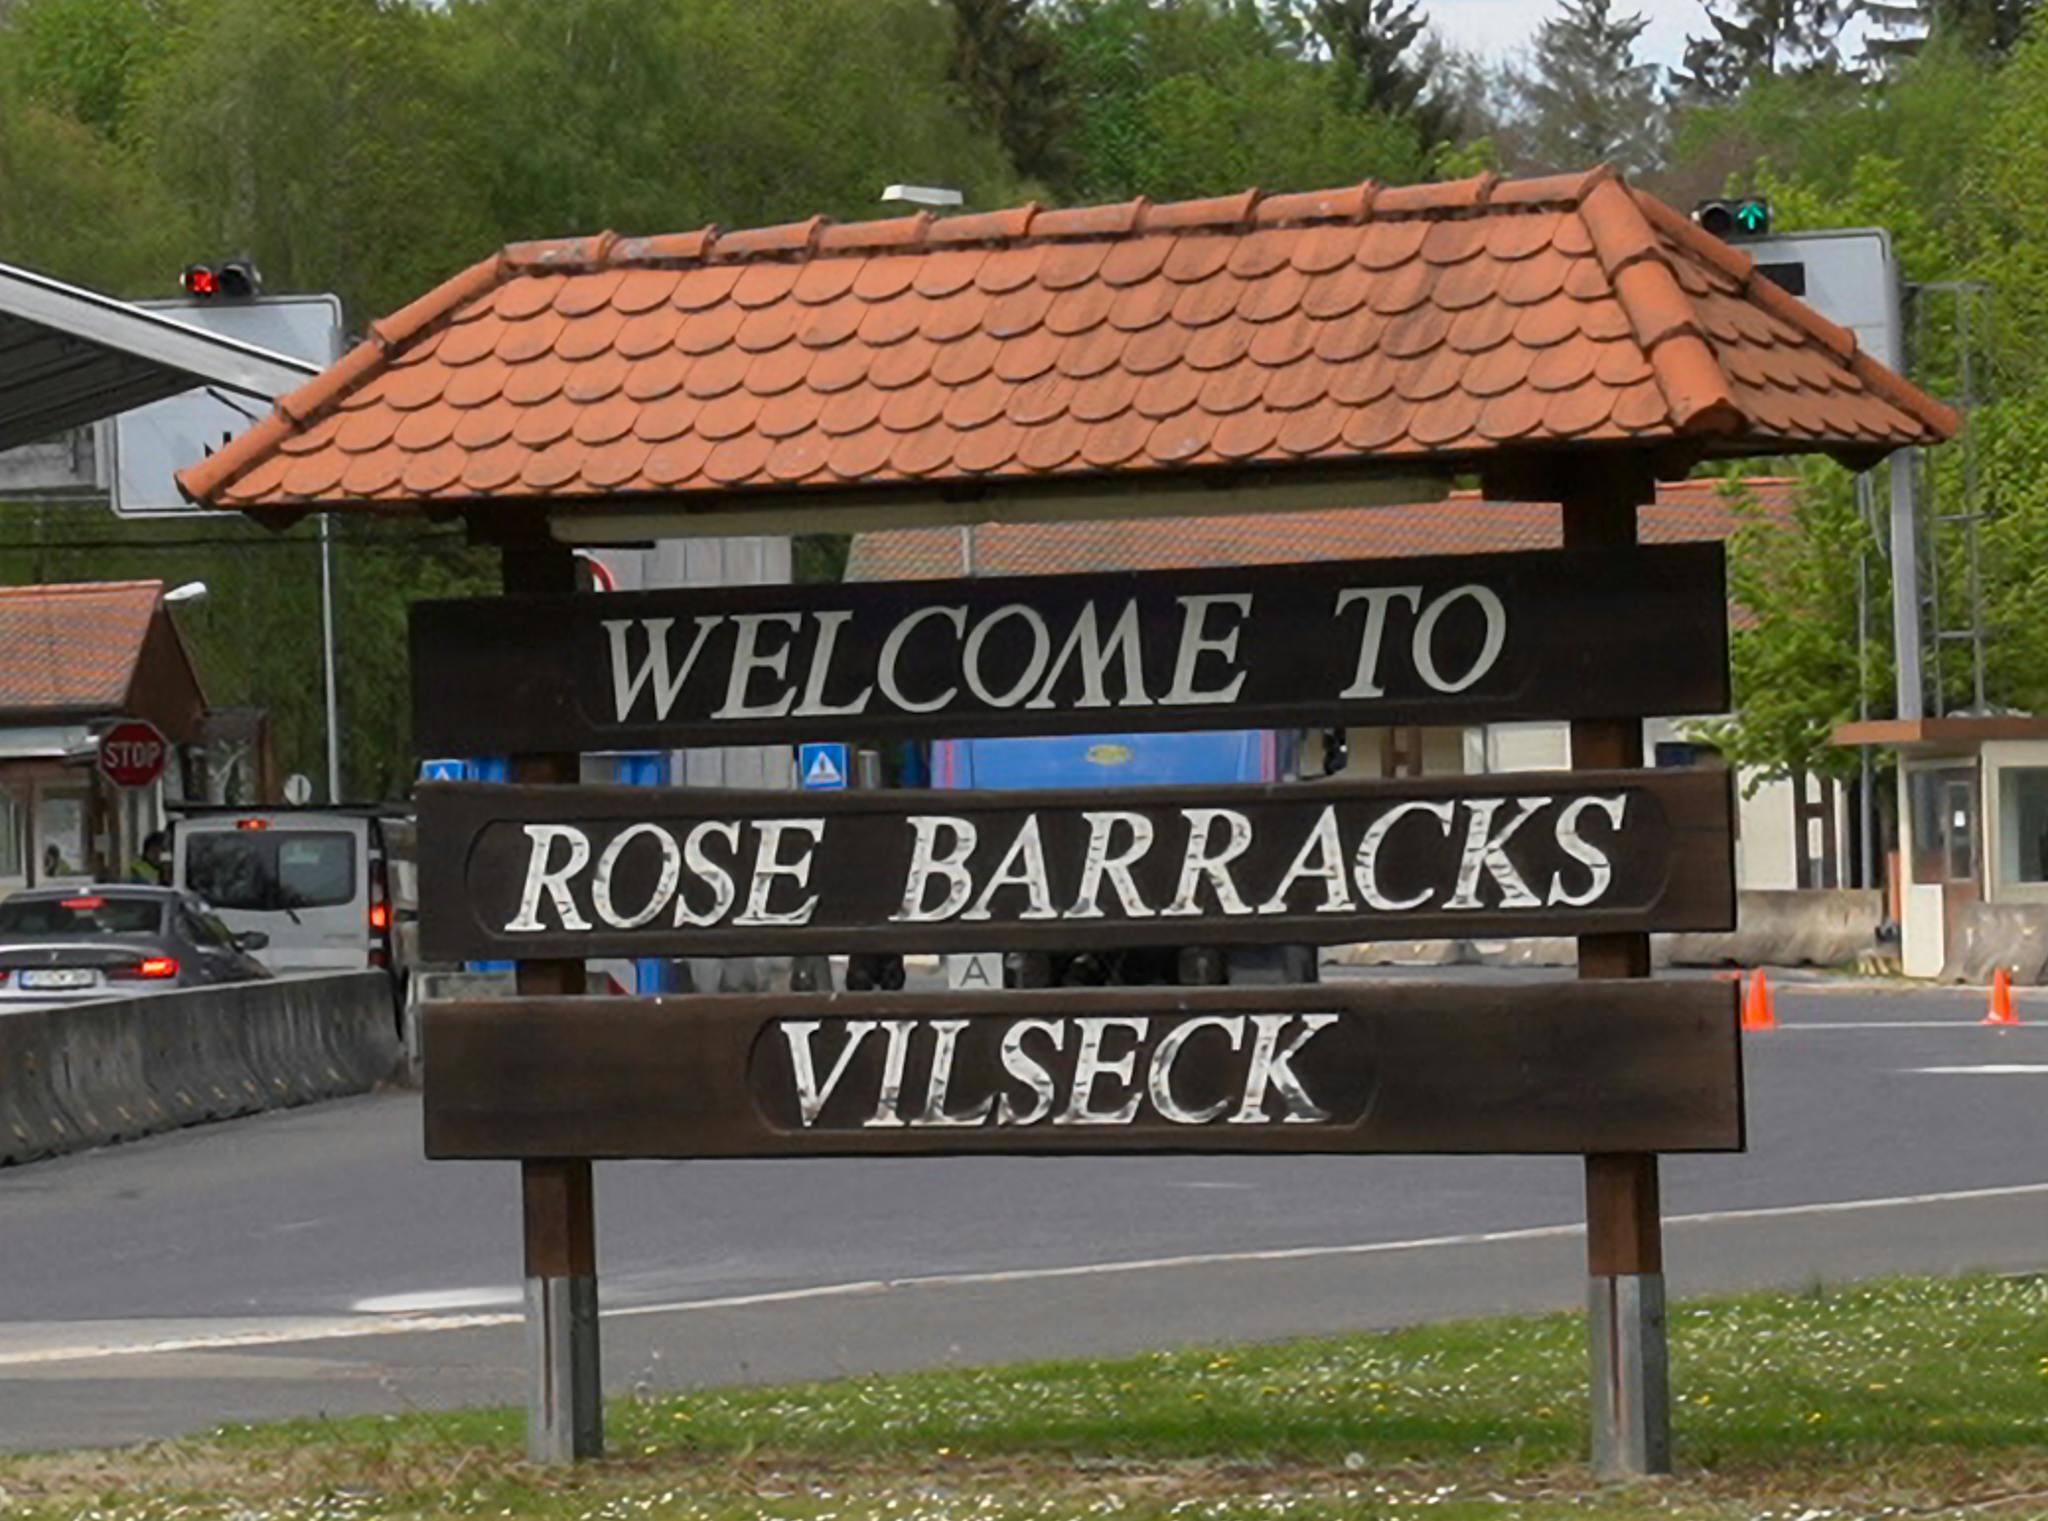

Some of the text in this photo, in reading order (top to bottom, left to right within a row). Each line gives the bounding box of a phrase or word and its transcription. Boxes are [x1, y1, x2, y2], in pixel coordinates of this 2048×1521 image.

[601, 583, 1508, 723] WELCOME TO
[104, 741, 161, 769] STOP
[504, 793, 1628, 934] ROSE BARRACKS
[960, 956, 990, 986] A
[779, 1012, 1341, 1129] VILSECK
